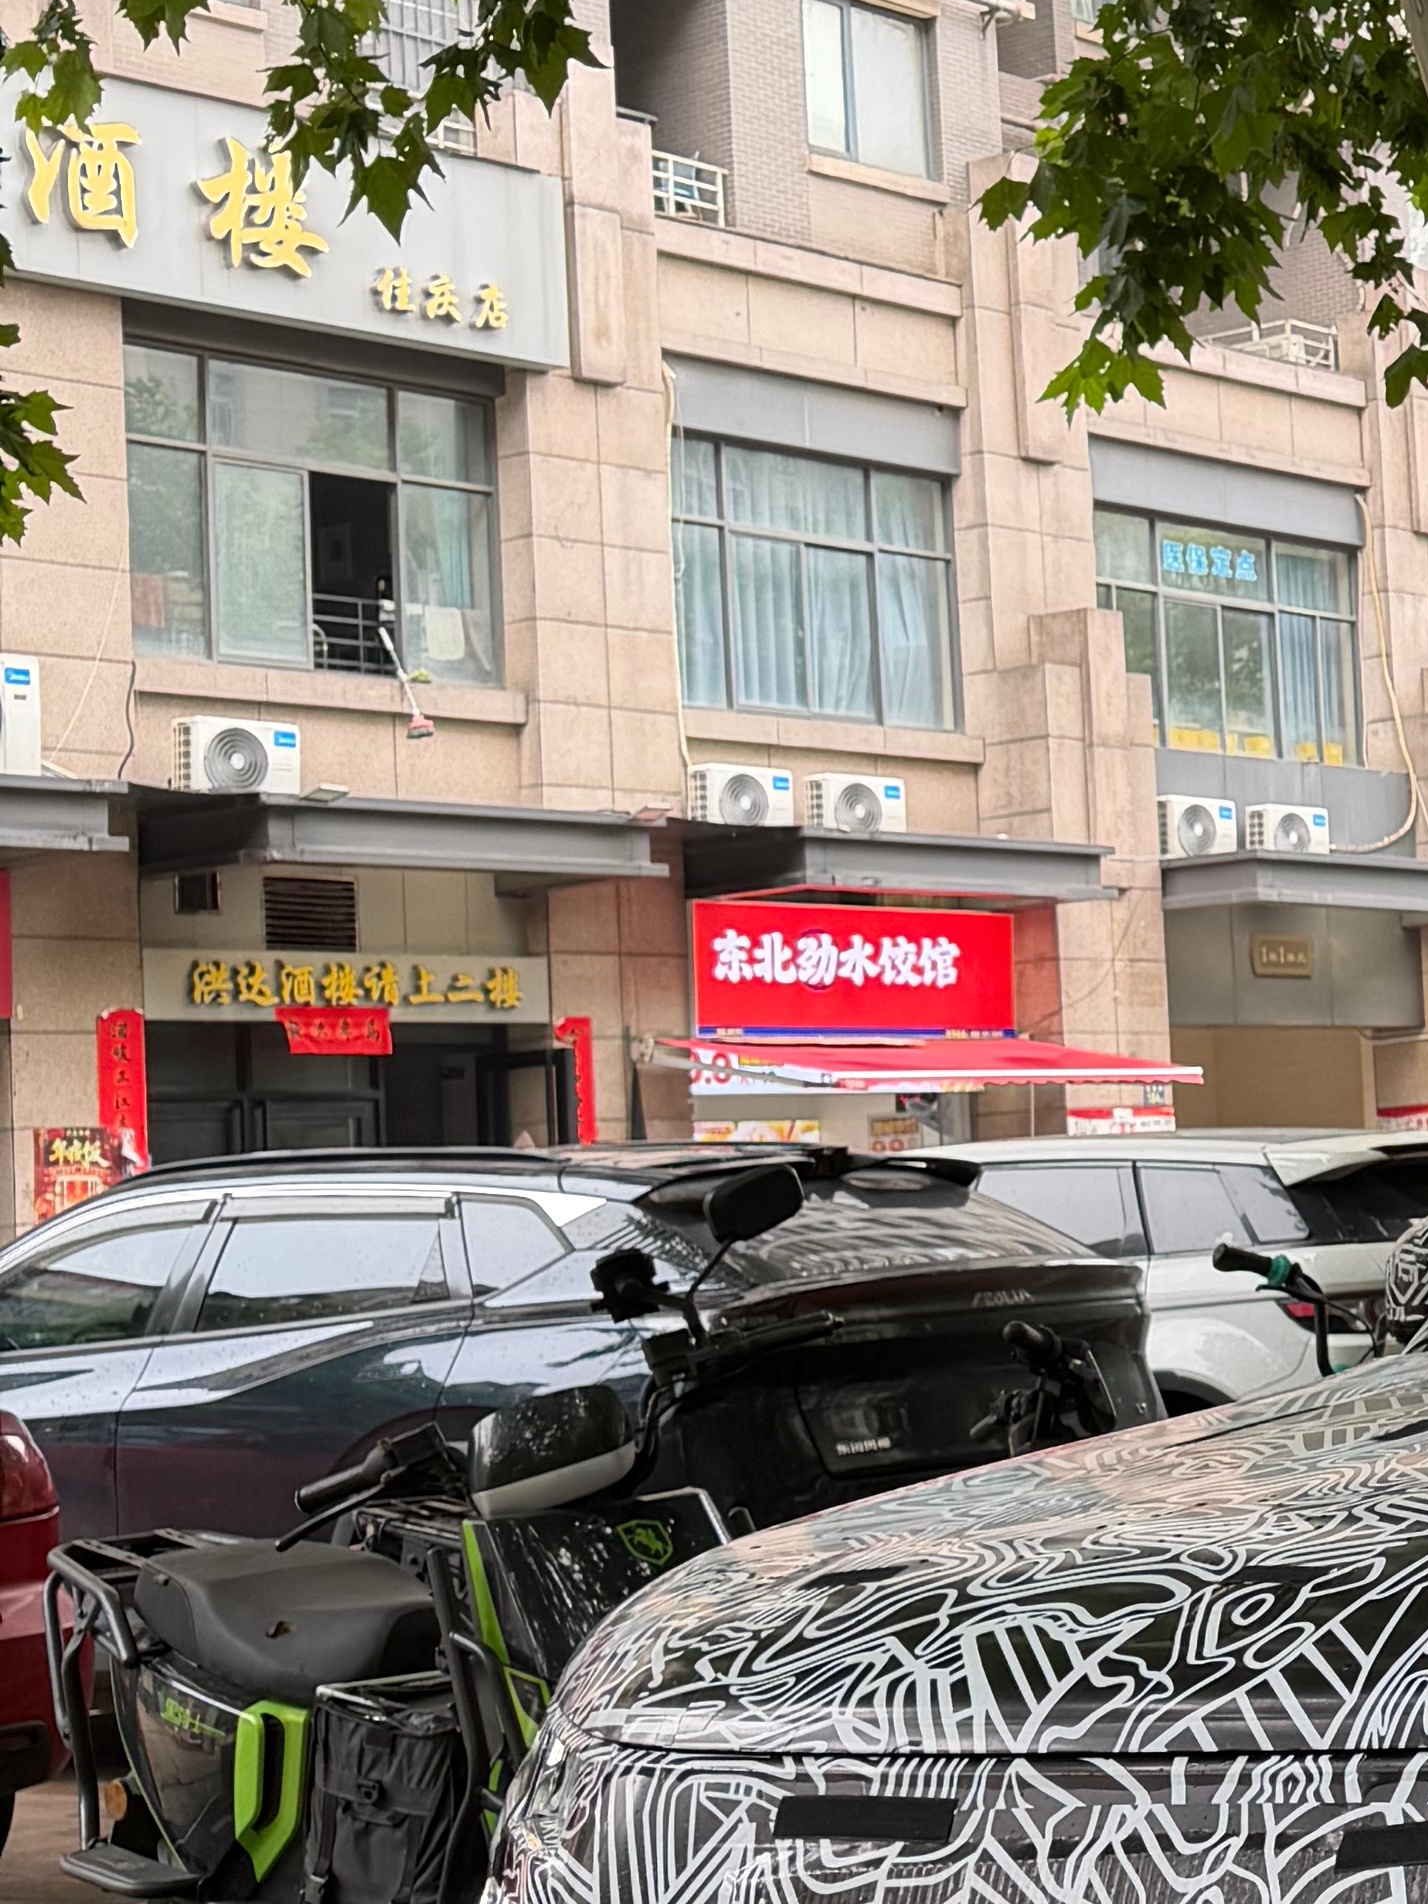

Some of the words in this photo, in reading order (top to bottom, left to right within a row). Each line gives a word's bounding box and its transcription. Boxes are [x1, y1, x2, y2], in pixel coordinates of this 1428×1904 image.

[1162, 539, 1258, 582] 医保定点
[713, 928, 960, 988] 东北劲水饺馆
